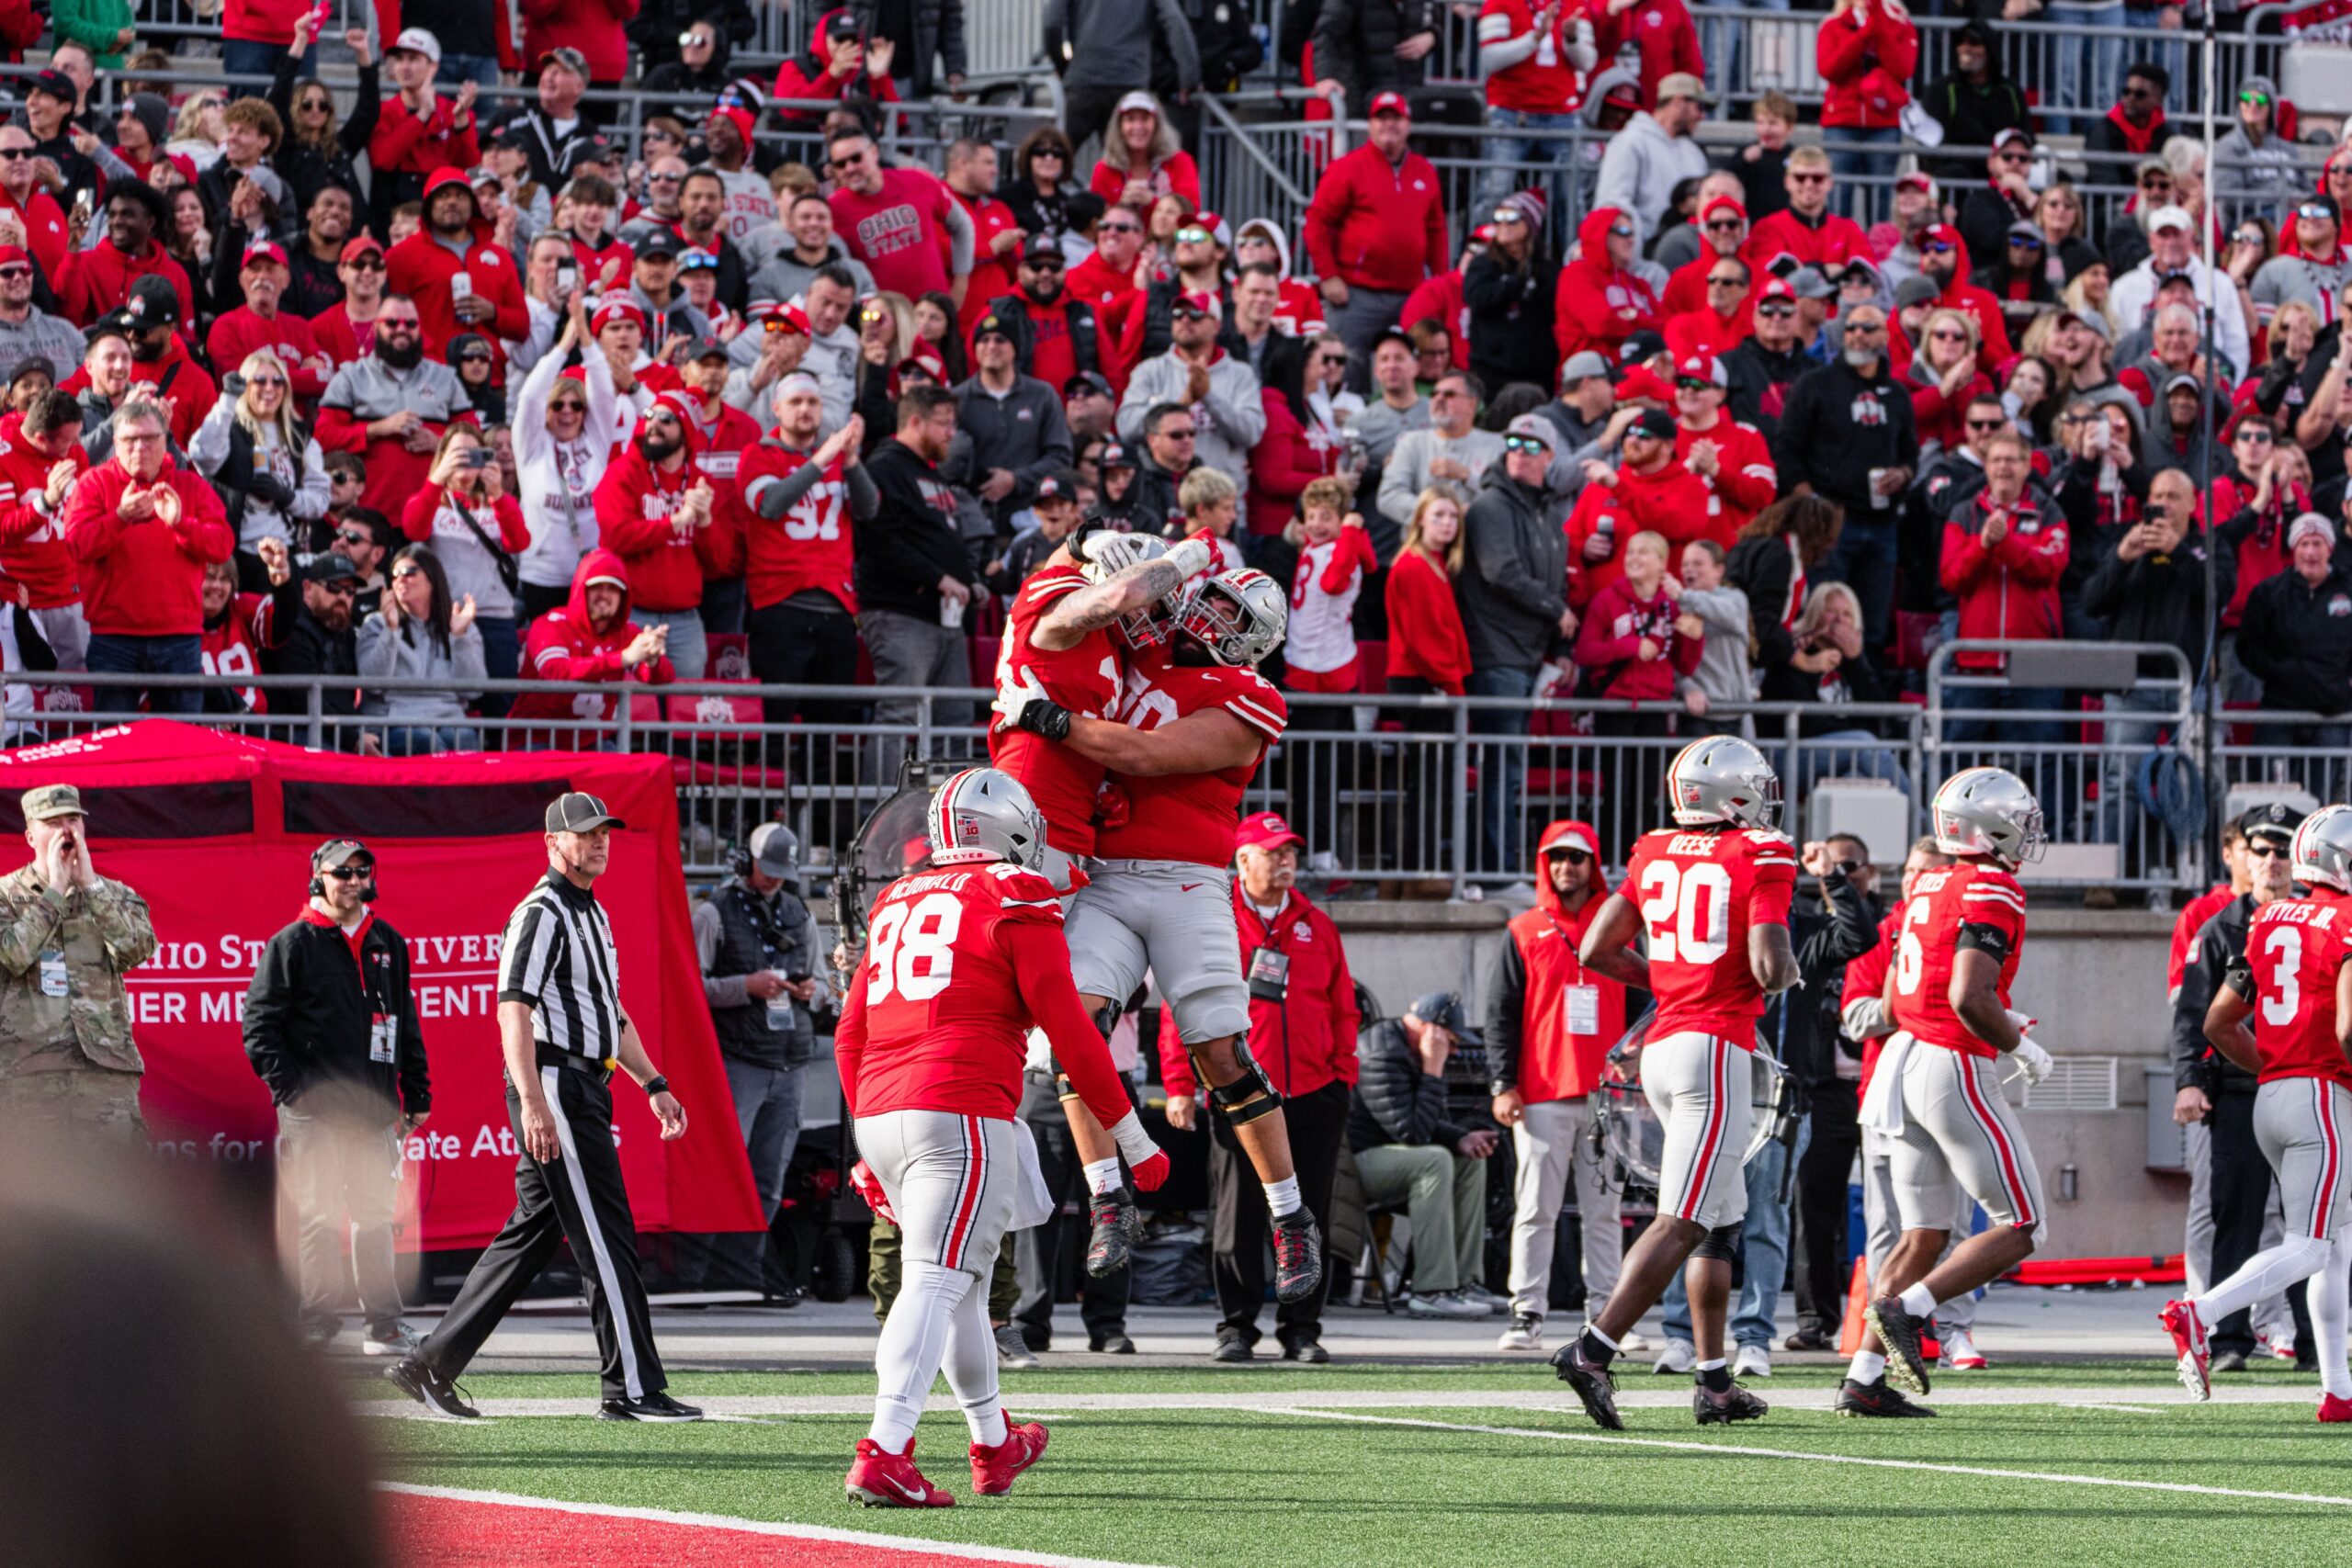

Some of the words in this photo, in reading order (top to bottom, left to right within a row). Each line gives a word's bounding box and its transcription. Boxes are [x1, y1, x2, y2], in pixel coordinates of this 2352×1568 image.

[857, 203, 920, 242] OHIO
[865, 226, 922, 258] STATE
[1666, 834, 1722, 856] REESE
[1641, 859, 1732, 964] 20
[2262, 903, 2316, 924] STYLES
[2309, 904, 2337, 931] JR.
[405, 933, 503, 964] IVER
[866, 893, 964, 1007] 98
[1897, 897, 1930, 996] 6
[2262, 925, 2302, 1026] 3
[410, 984, 494, 1018] ENT
[208, 1131, 264, 1163] for
[397, 1131, 461, 1161] ate
